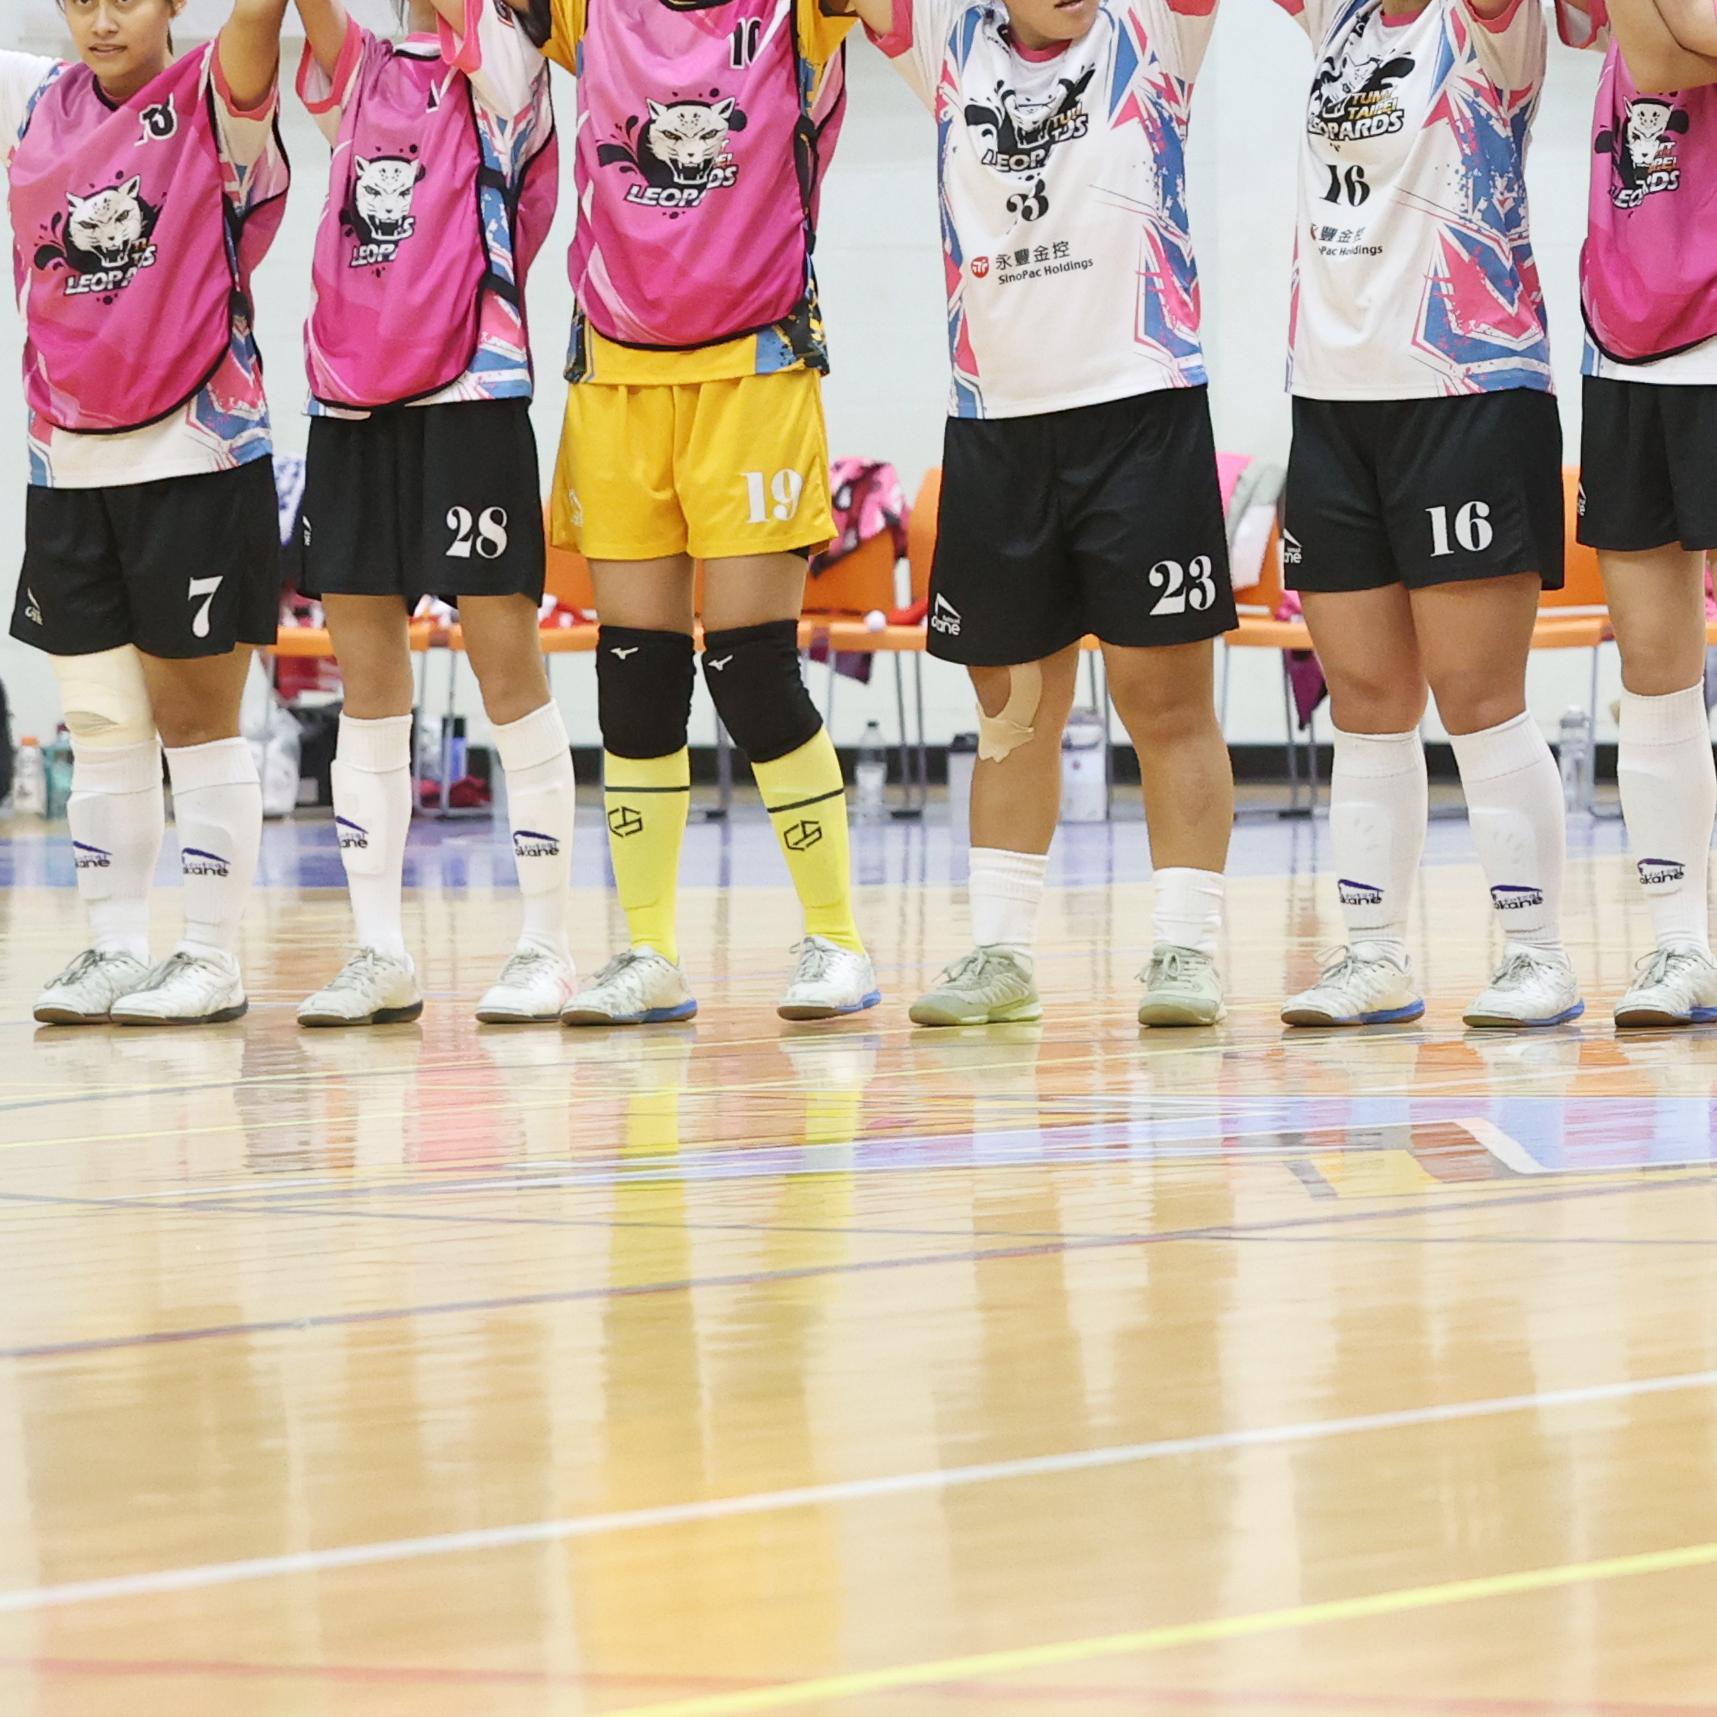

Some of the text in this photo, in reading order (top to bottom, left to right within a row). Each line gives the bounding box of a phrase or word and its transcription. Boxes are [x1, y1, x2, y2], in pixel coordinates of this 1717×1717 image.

[1319, 163, 1370, 207] 16
[995, 239, 1071, 271] 永豐金控
[998, 257, 1094, 285] SinoPac Holdings
[741, 468, 804, 526] 19
[445, 505, 509, 559] 28
[1425, 500, 1494, 558] 16
[187, 575, 223, 638] 7
[1149, 555, 1217, 616] 23
[1493, 895, 1544, 910] okane
[1640, 871, 1684, 885] okane
